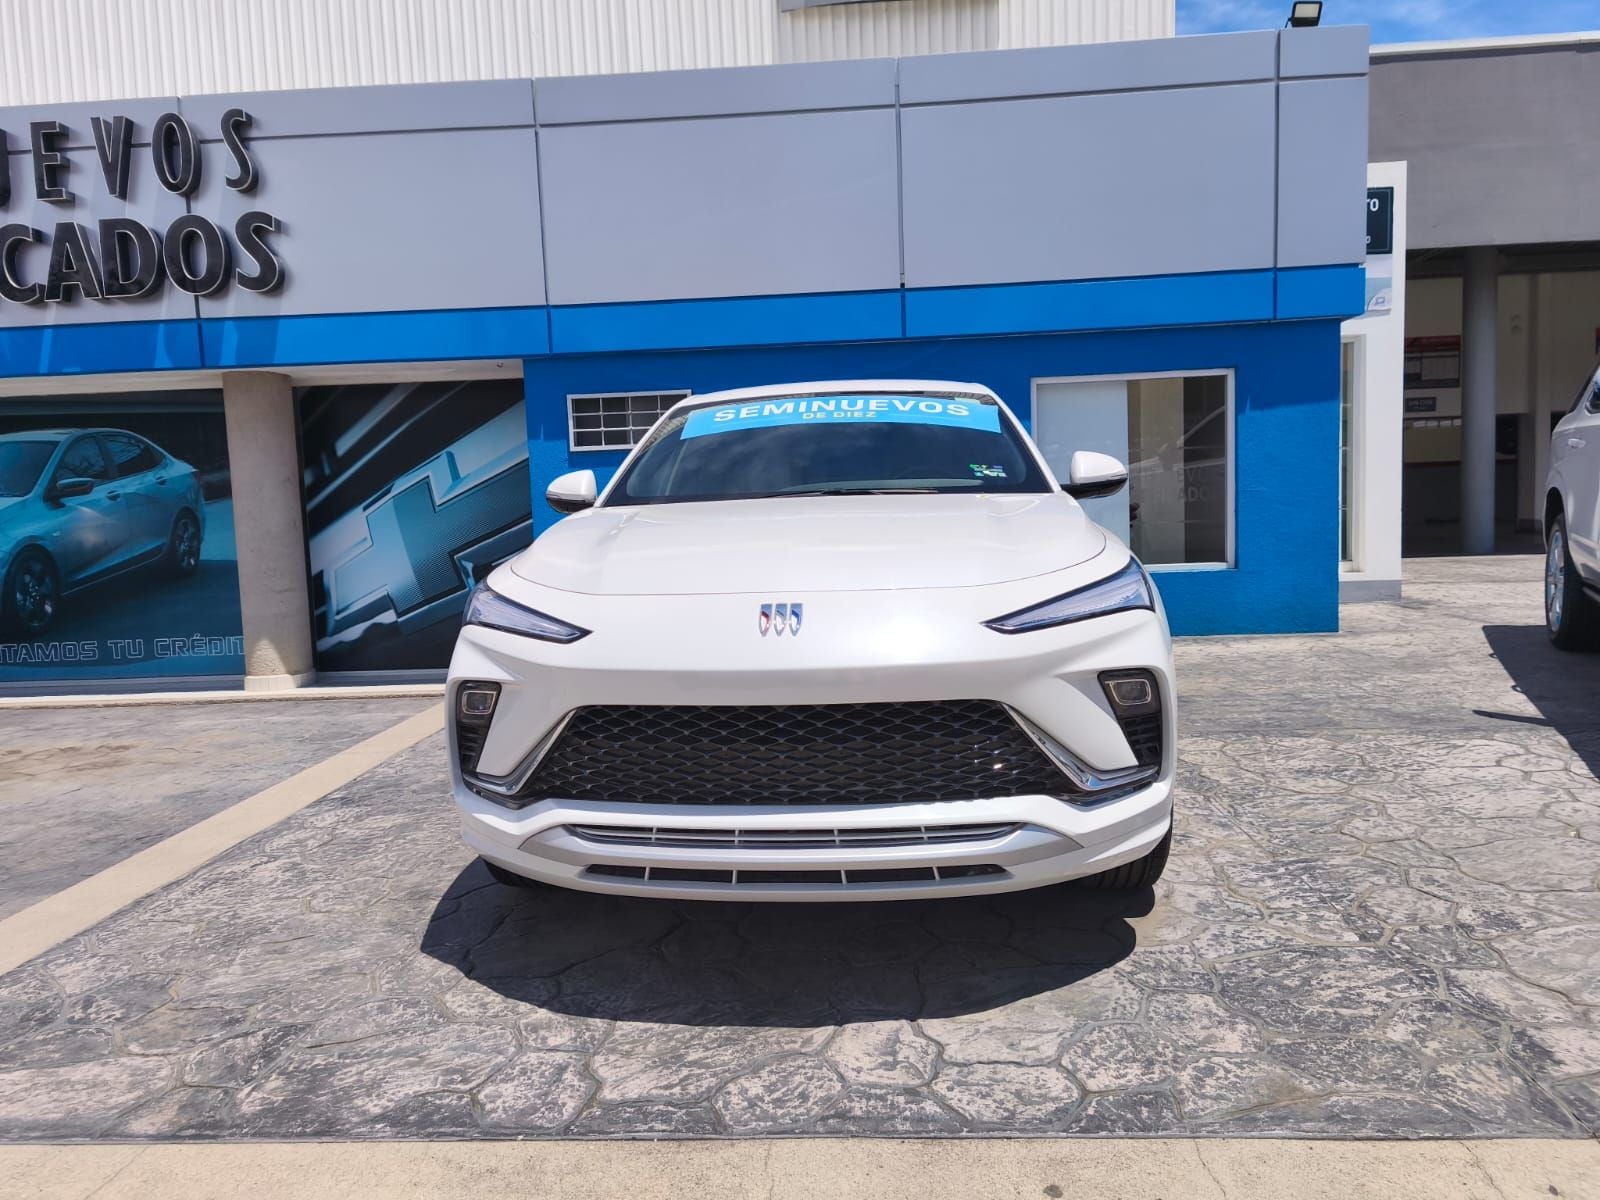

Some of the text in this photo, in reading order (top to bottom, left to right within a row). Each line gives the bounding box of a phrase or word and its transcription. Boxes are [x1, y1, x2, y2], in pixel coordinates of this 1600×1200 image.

[0, 210, 285, 304] CADOS
[713, 399, 970, 422] SEMINUEVOS
[802, 410, 877, 420] DE DIEZ
[0, 640, 98, 663] TAMOS
[107, 639, 144, 660] TU
